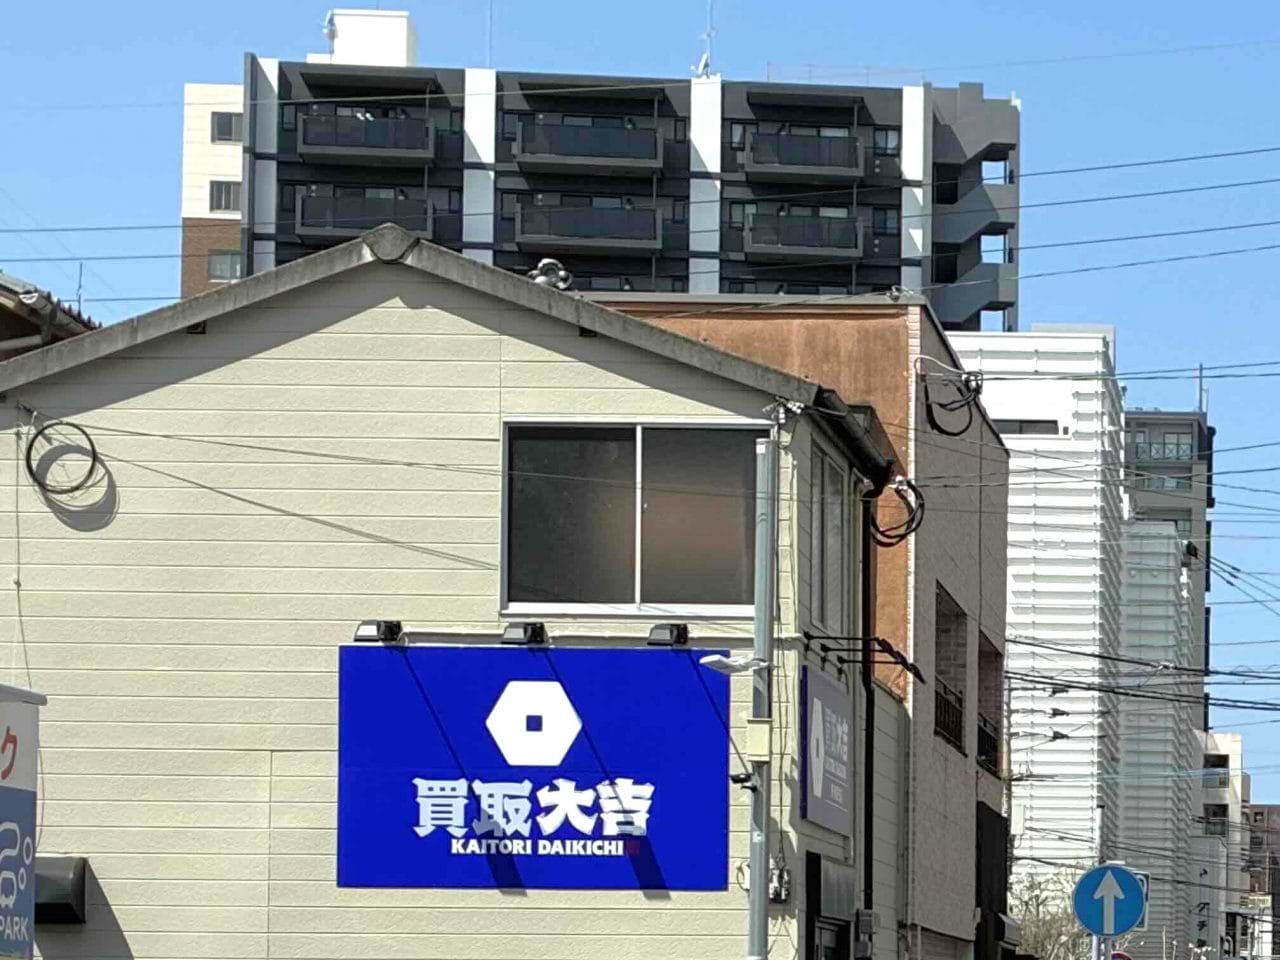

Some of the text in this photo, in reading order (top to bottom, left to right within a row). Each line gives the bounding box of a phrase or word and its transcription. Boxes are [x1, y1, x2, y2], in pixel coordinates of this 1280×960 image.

[412, 777, 656, 837] 買取大吉
[450, 838, 532, 856] KAITORI
[537, 838, 624, 857] DAIKICHI
